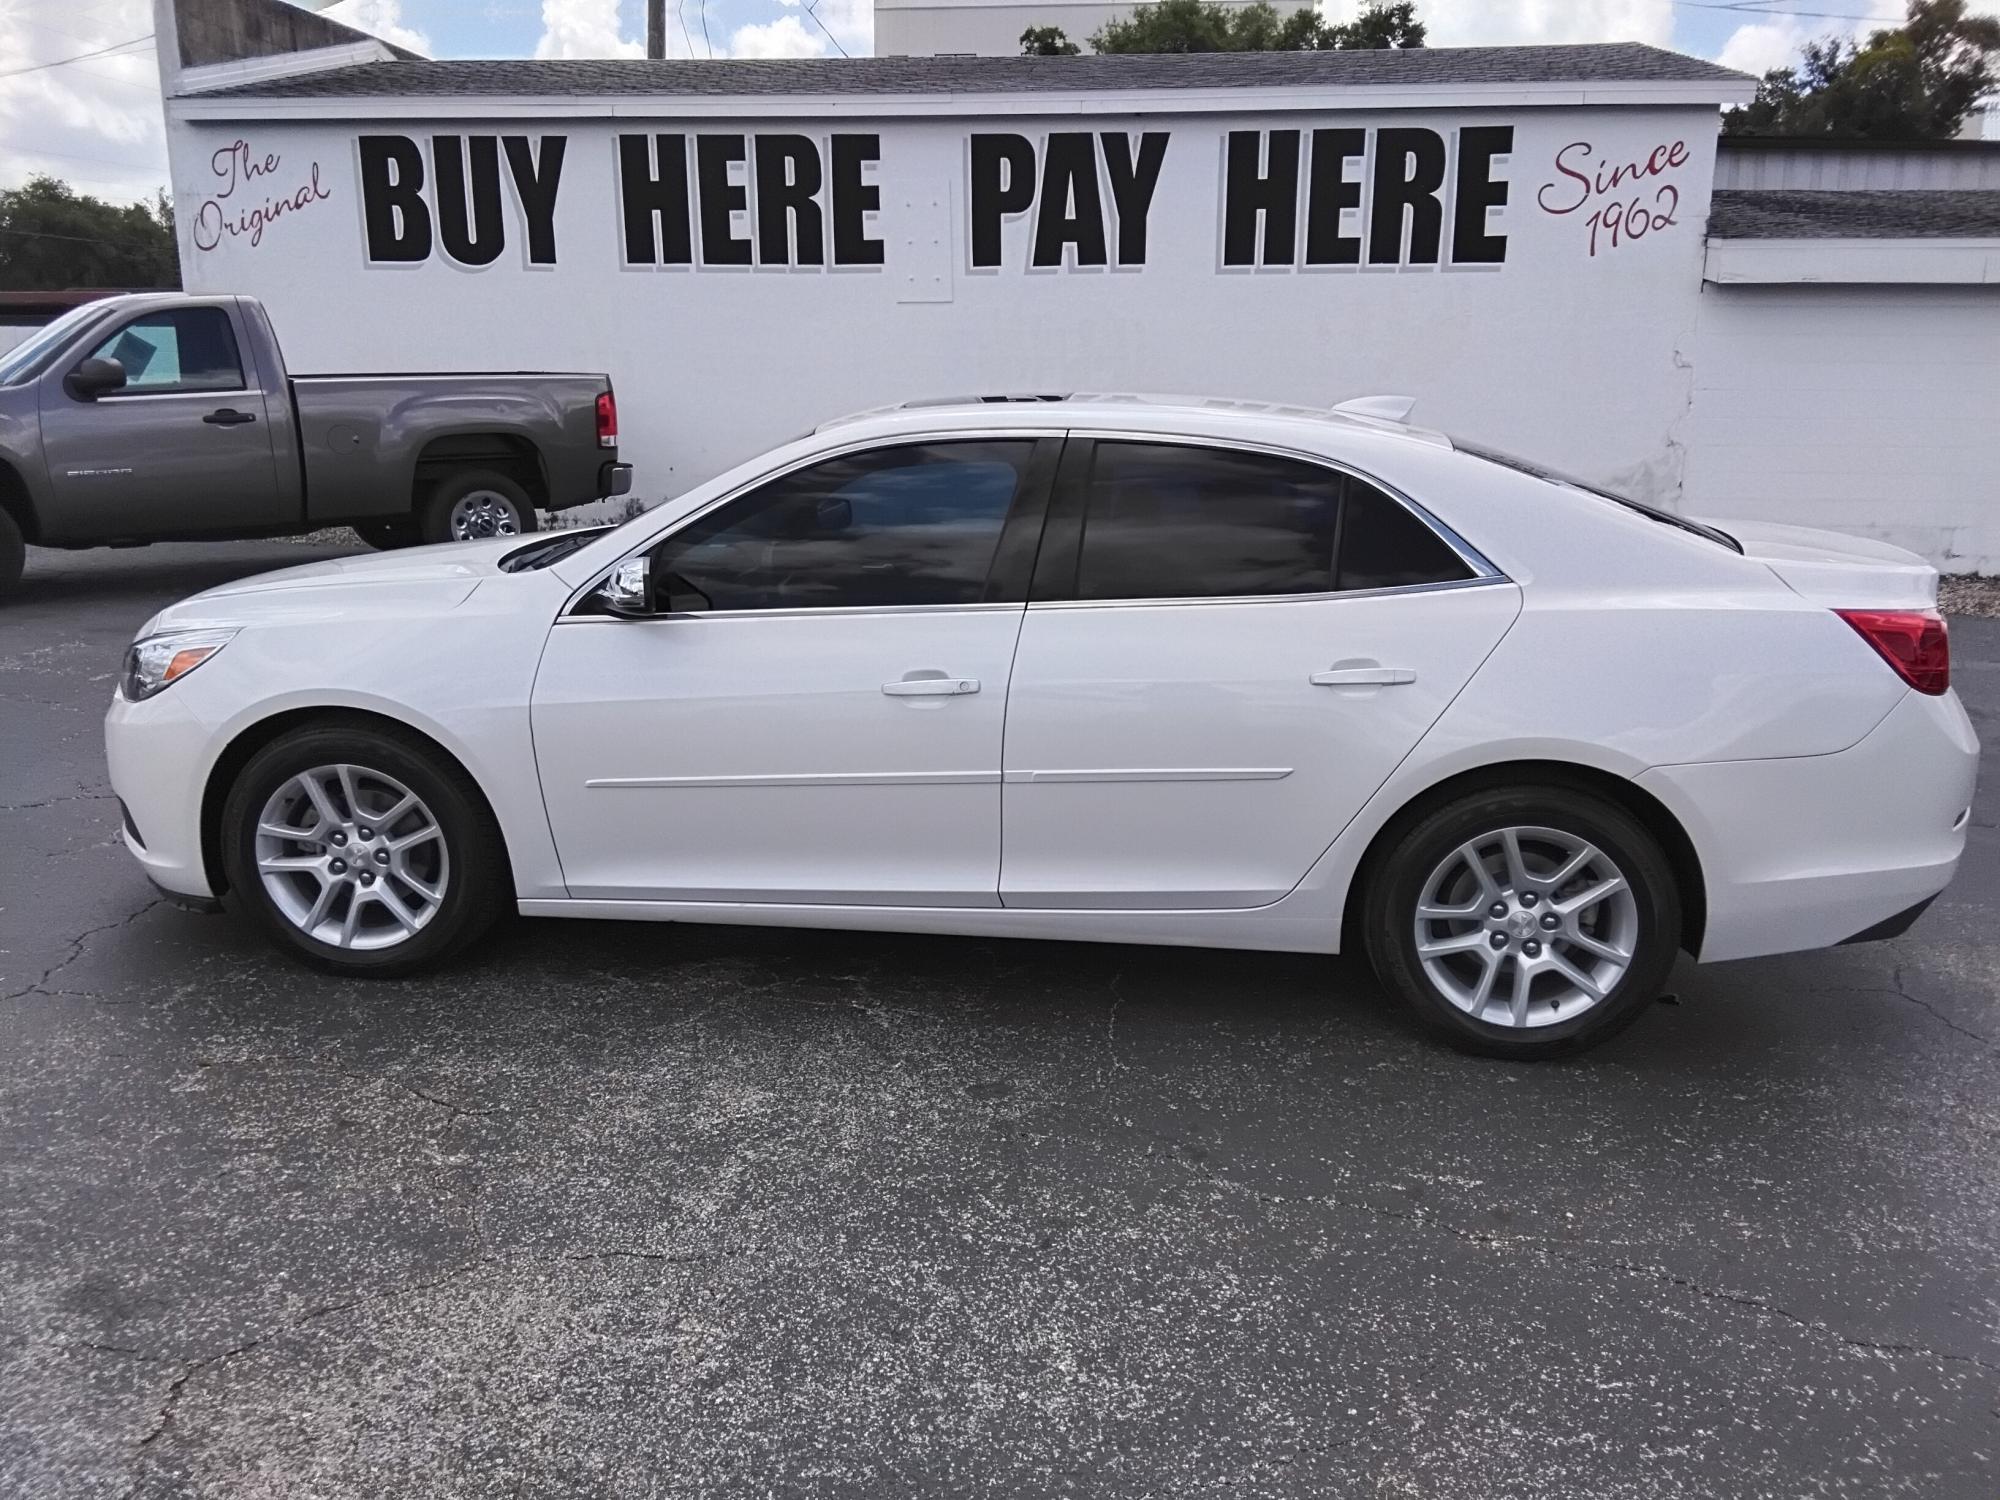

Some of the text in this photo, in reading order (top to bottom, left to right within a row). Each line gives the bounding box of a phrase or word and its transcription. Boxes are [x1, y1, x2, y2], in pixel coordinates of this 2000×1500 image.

[210, 140, 281, 198] The
[358, 126, 1514, 266] BUY HERE PAY HERE
[1537, 140, 1690, 214] Since
[193, 162, 331, 251] Original
[1586, 184, 1679, 256] 1962
